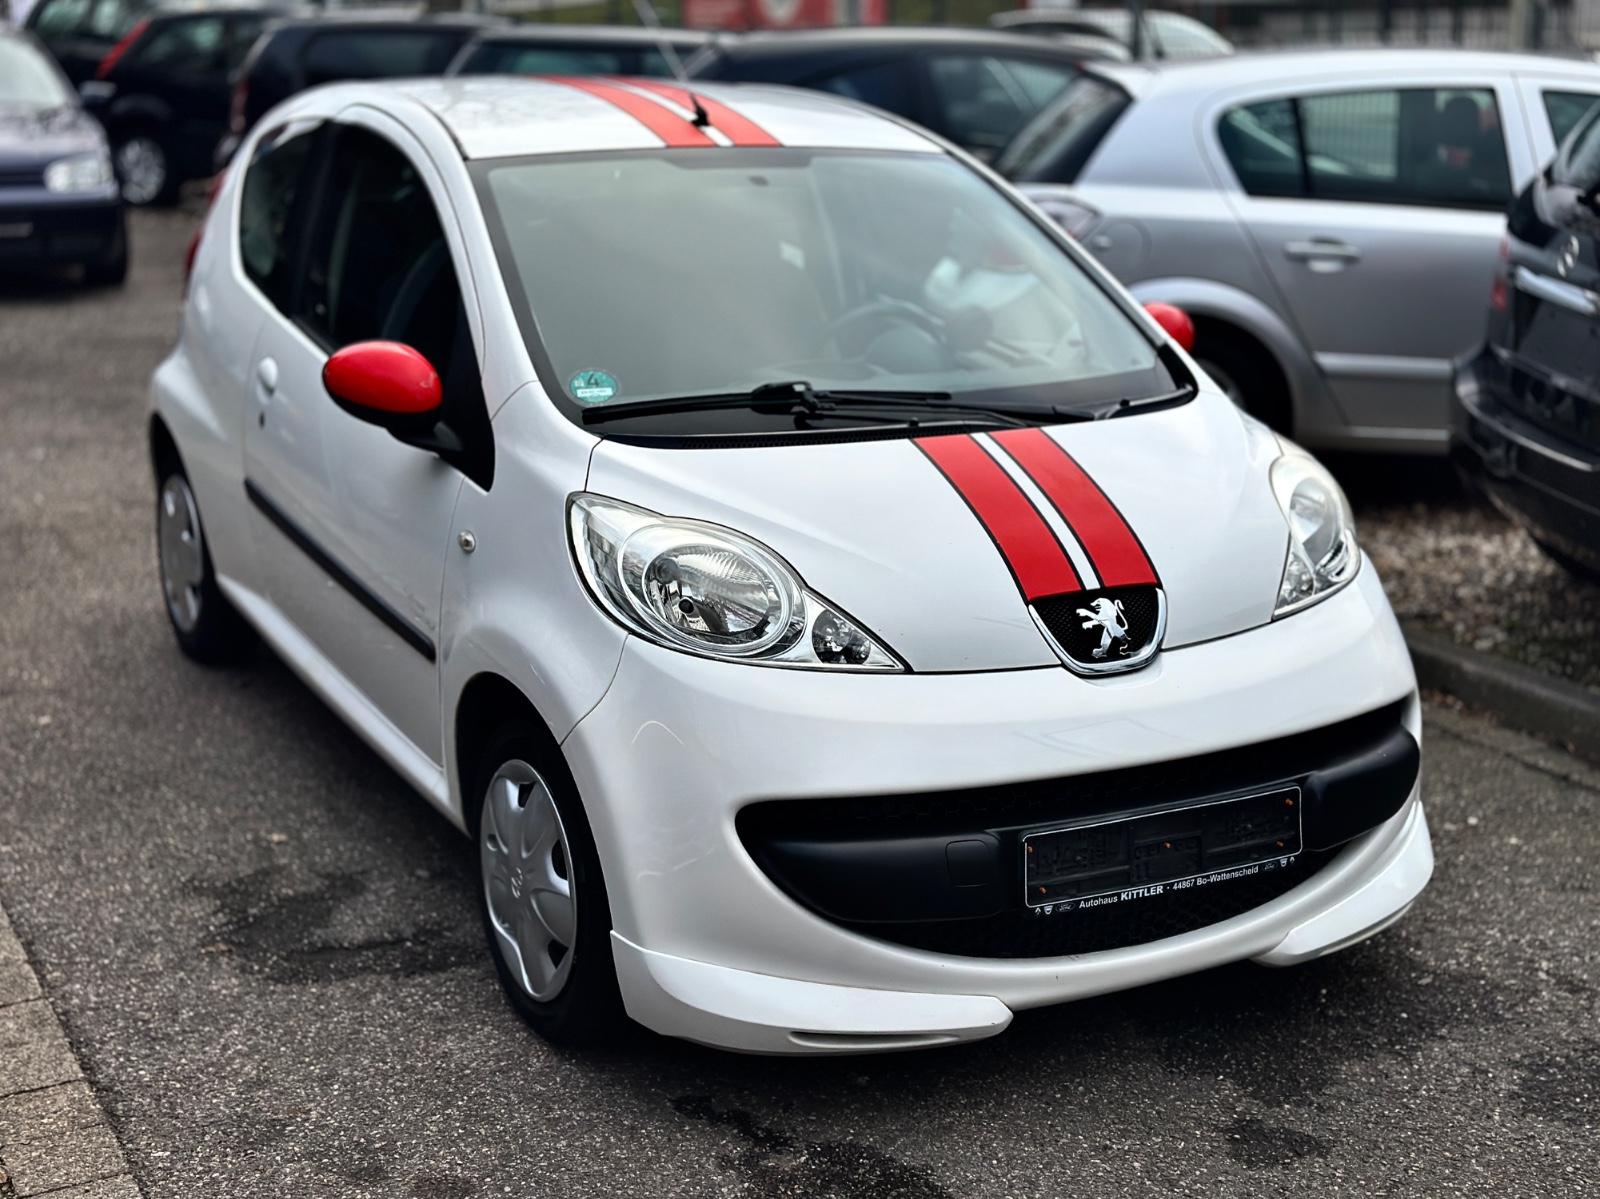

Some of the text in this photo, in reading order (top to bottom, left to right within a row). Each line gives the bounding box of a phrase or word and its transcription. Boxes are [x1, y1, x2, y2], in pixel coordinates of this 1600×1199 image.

[587, 372, 599, 386] 4
[1079, 895, 1118, 909] Autohaus
[1120, 886, 1164, 902] KITTLER
[1172, 879, 1195, 891] 44867
[1196, 866, 1259, 886] Bo-Wattenscheid
